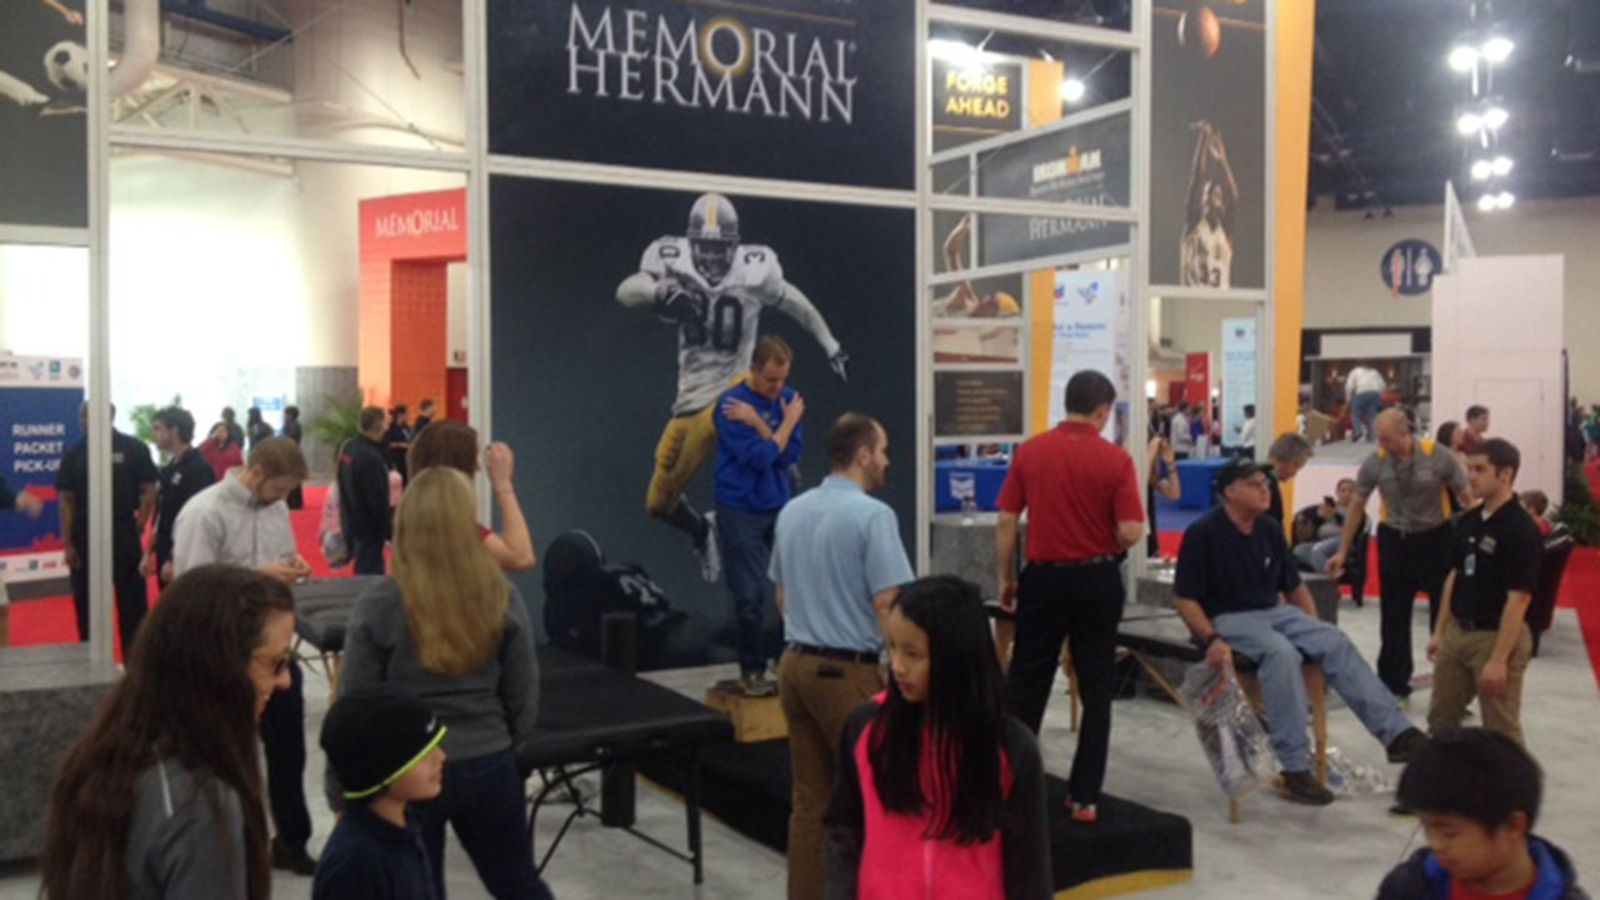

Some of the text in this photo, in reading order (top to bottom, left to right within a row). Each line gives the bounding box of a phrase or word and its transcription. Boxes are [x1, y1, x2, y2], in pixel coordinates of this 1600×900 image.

[565, 1, 857, 85] MEMORIAL
[566, 45, 855, 125] HERMANN
[945, 71, 1009, 95] FORGE
[945, 97, 1010, 118] AHEAD
[375, 207, 459, 238] MEMORIAL
[13, 424, 65, 436] RUNNER
[14, 442, 64, 455] PACKET
